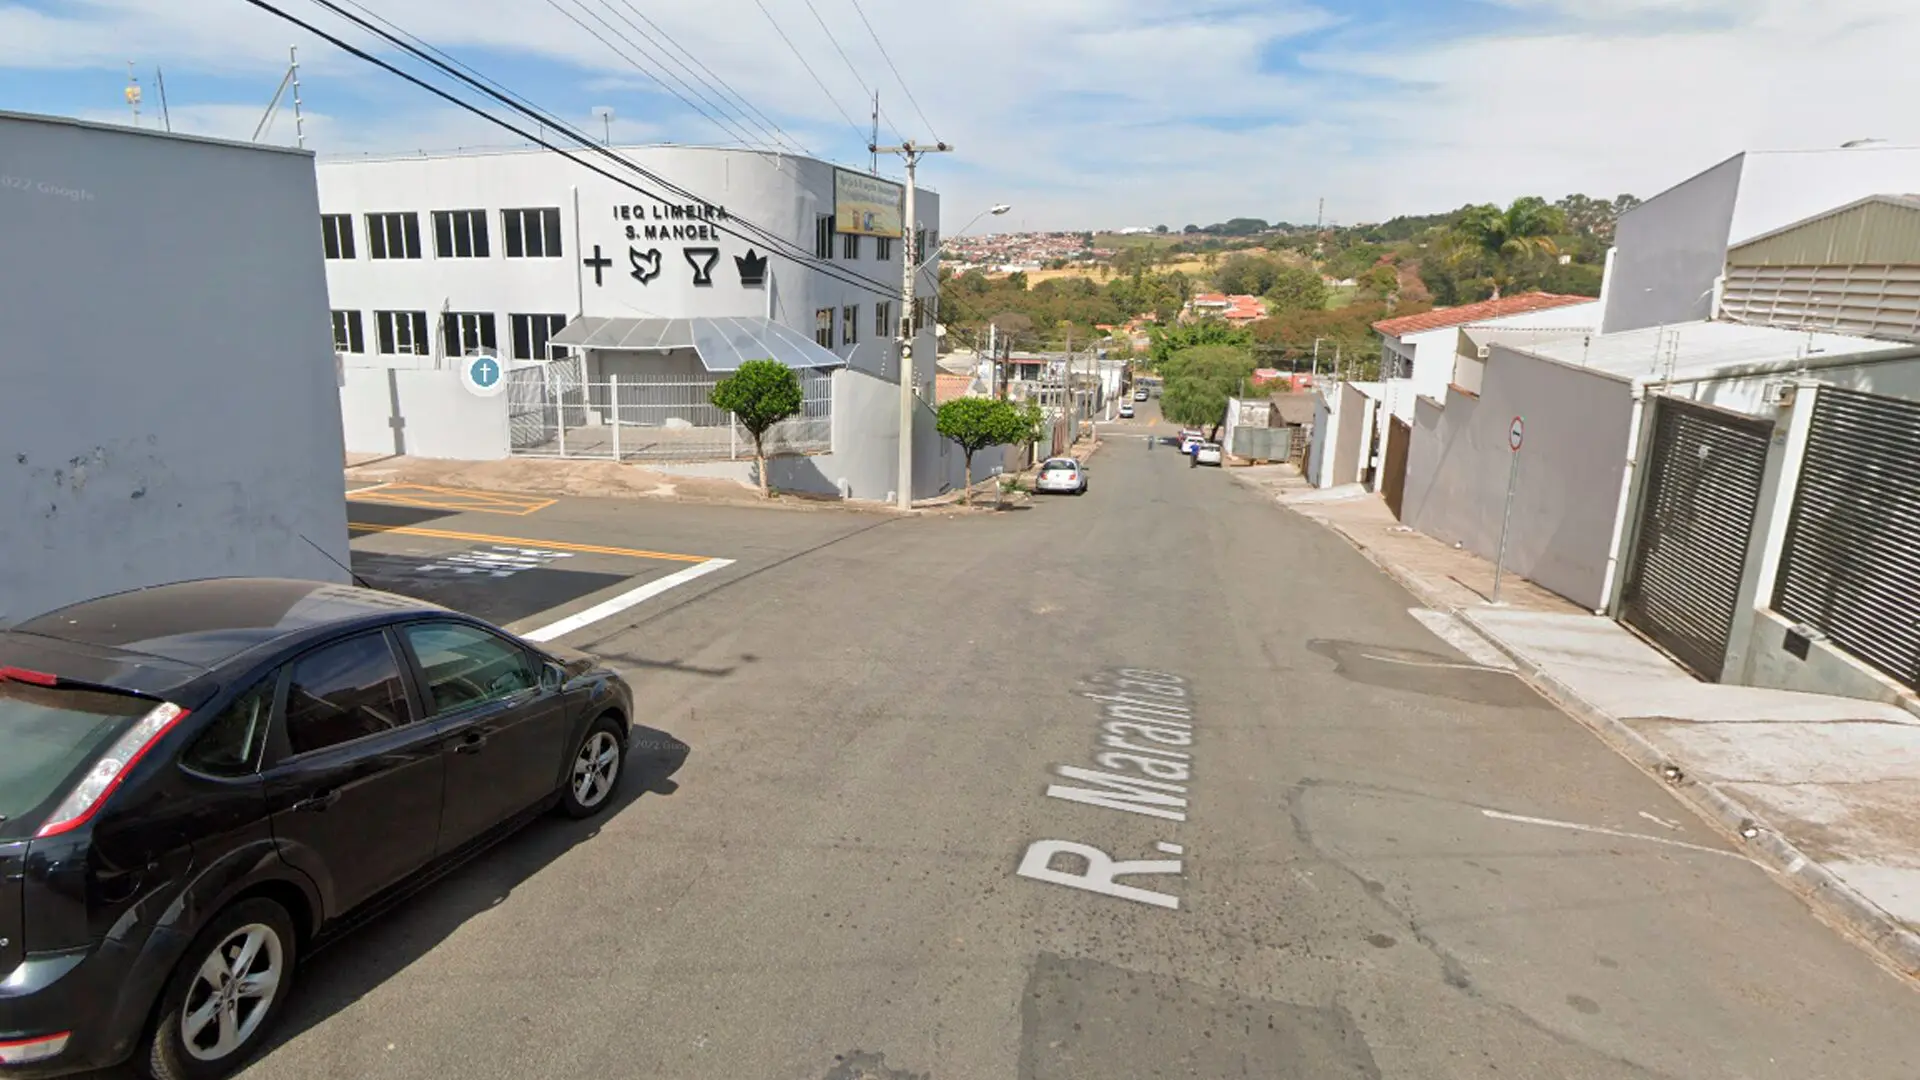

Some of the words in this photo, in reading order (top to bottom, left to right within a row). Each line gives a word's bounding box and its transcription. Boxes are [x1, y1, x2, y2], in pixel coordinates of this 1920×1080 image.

[613, 204, 645, 220] IEQ
[652, 204, 729, 220] LIMEIRA
[625, 225, 641, 240] S.
[644, 225, 720, 240] MANOEL
